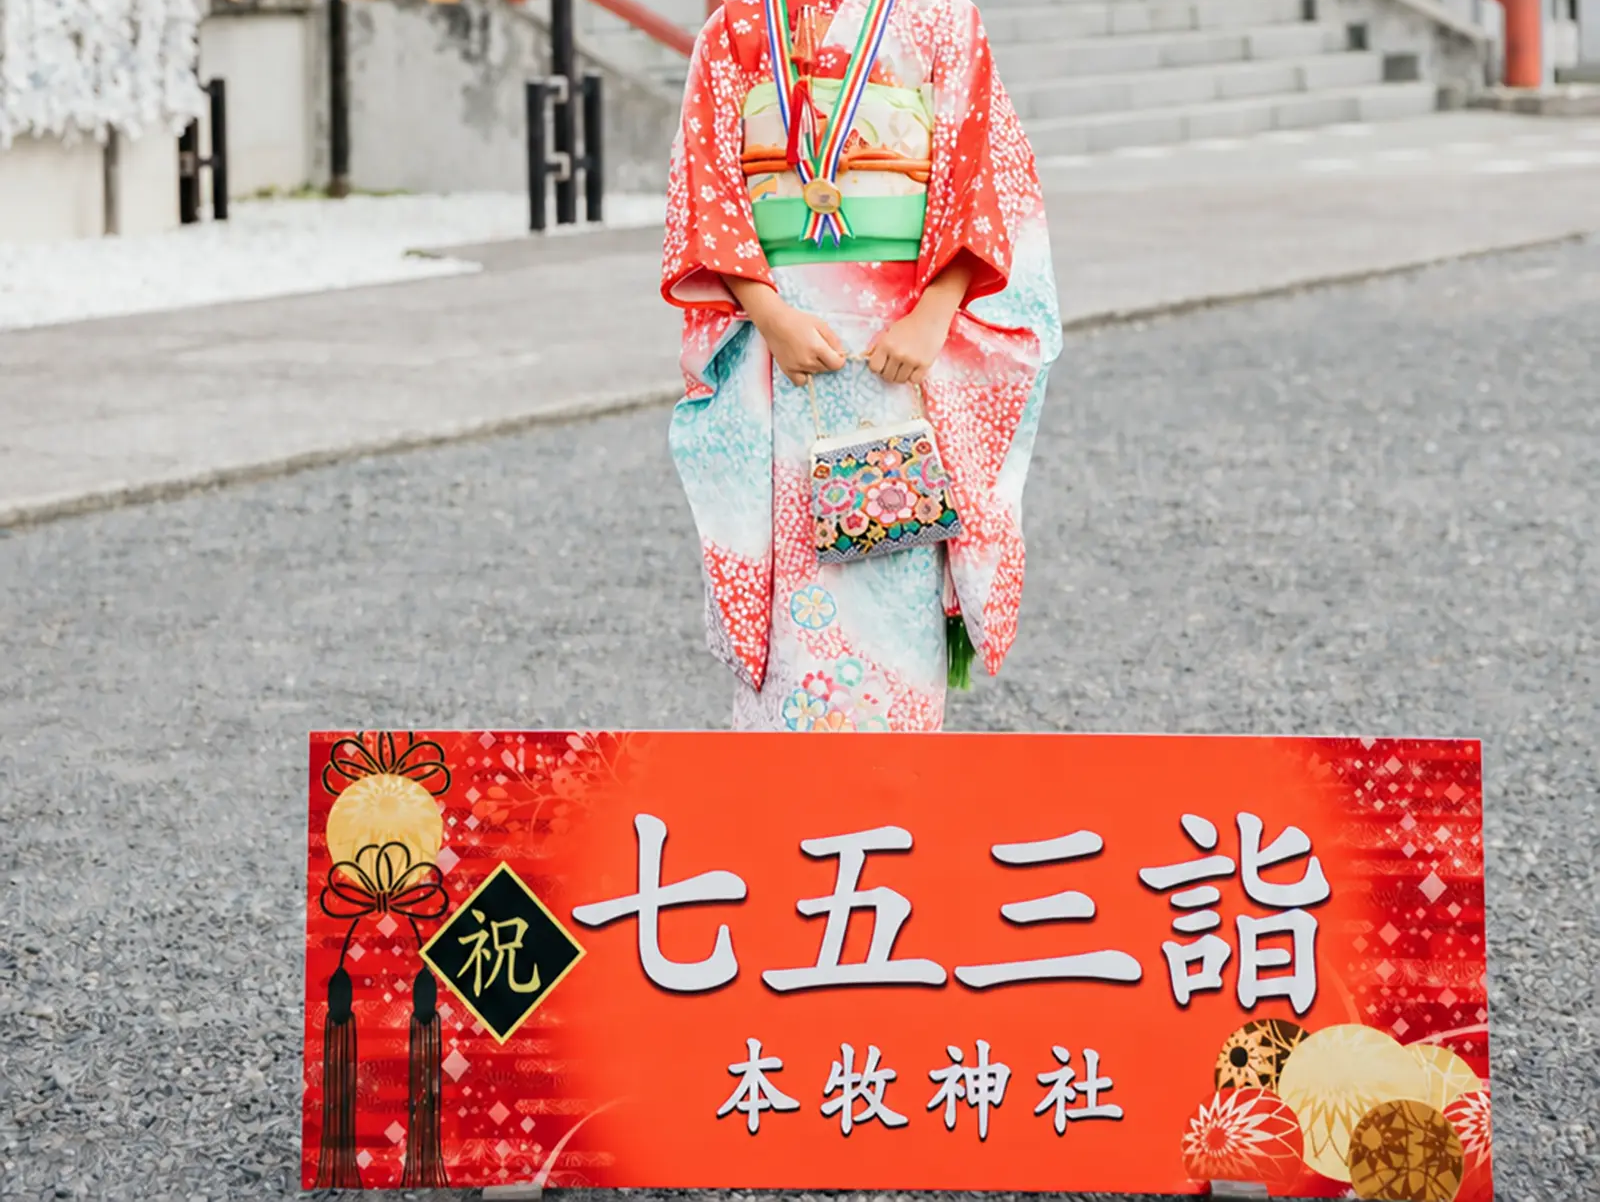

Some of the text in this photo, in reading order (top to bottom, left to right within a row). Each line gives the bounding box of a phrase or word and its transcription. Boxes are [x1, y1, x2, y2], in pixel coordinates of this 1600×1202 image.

[456, 908, 542, 998] 祝
[571, 811, 1332, 1015] 七五三詣
[716, 1036, 1125, 1139] 本牧神社
